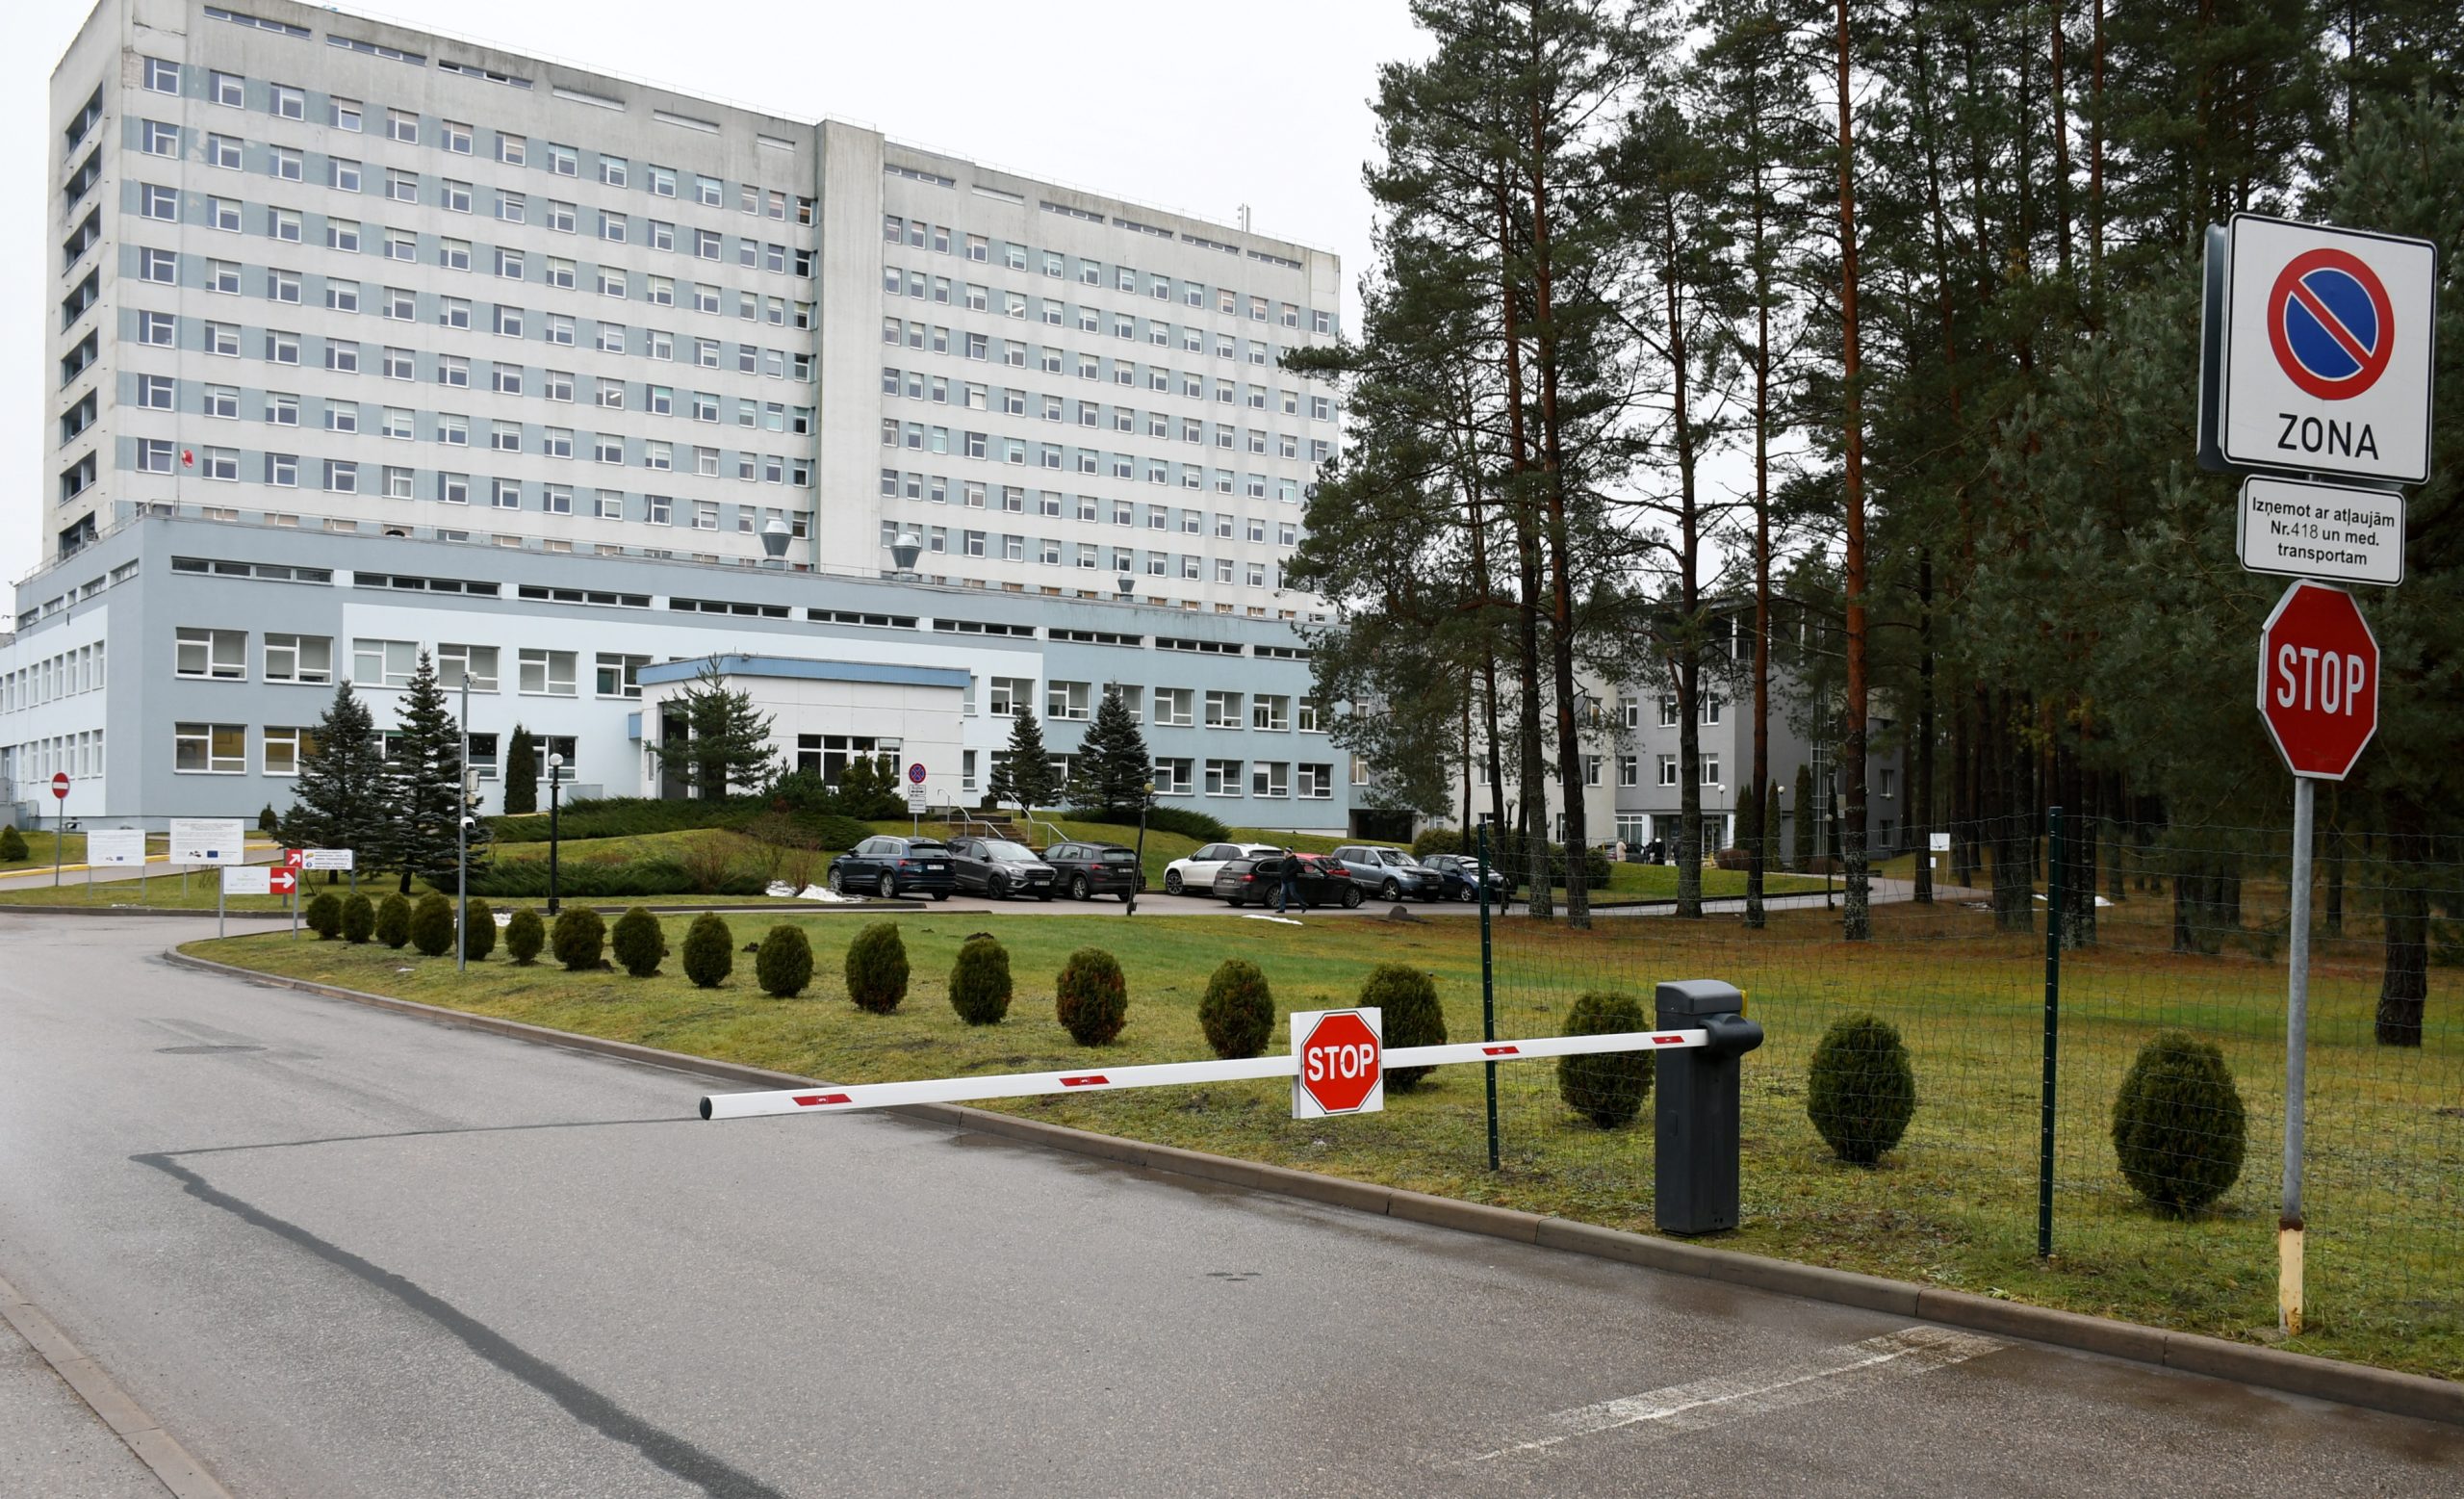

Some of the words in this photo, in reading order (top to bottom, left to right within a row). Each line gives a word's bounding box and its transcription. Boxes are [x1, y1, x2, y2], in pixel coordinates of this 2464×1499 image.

[2277, 412, 2379, 460] ZONA
[2252, 497, 2311, 518] Izņemot
[2315, 507, 2330, 520] ar
[2333, 508, 2395, 529] atļaujām
[2271, 520, 2319, 539] Nr.418
[2322, 529, 2340, 542] un
[2345, 531, 2379, 546] med.
[2277, 543, 2368, 566] transportam
[2276, 643, 2365, 716] STOP
[1307, 1044, 1374, 1081] STOP
